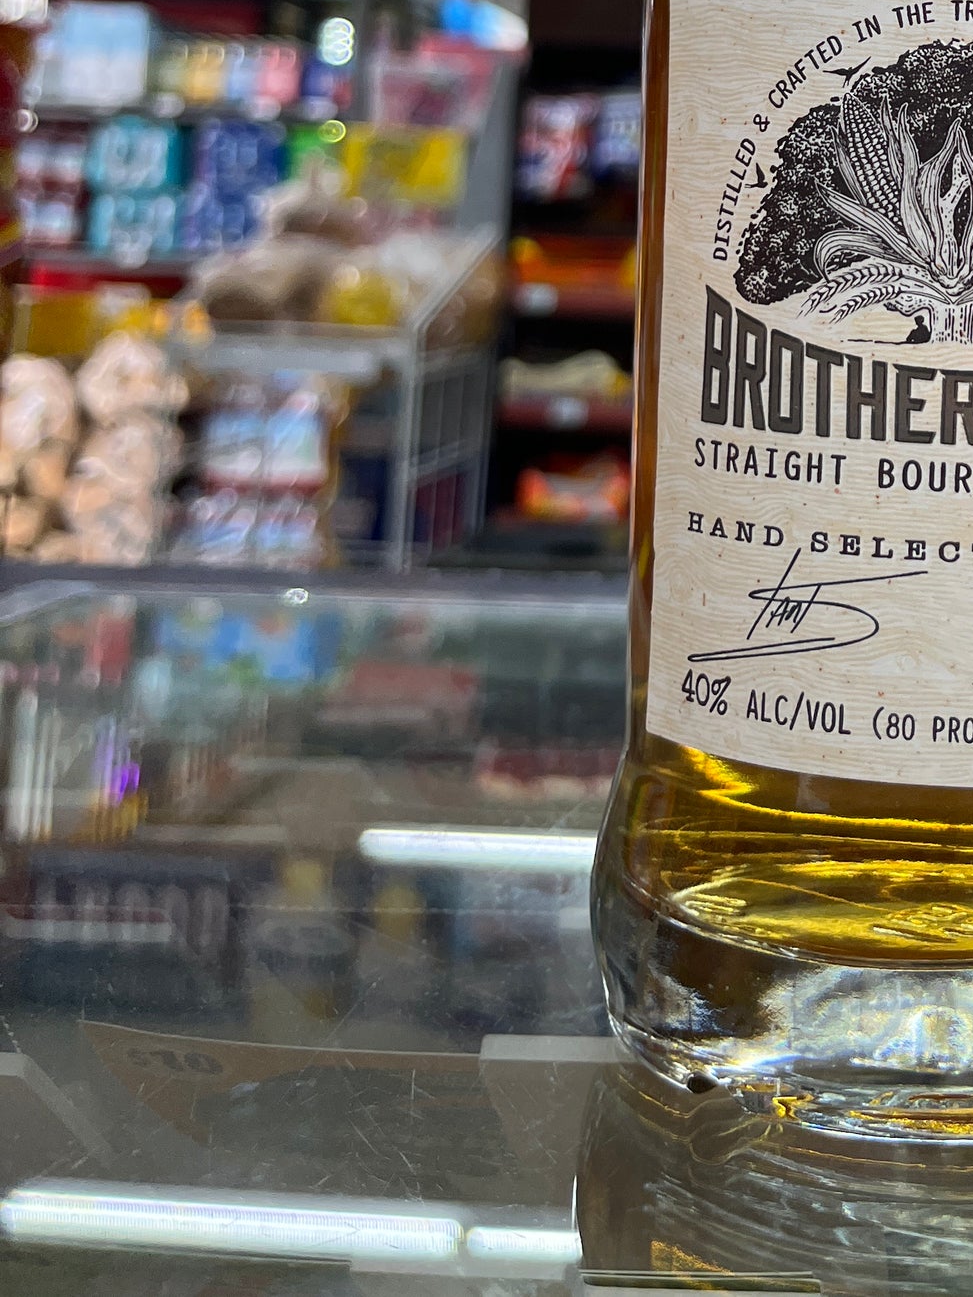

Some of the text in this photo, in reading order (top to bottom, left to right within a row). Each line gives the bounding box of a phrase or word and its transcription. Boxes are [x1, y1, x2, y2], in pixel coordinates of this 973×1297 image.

[712, 137, 756, 262] DISTILLED
[753, 113, 770, 132] &
[767, 35, 843, 109] CRAFTED
[851, 14, 881, 43] IN
[892, 1, 935, 28] THE
[695, 437, 847, 487] STRAIGHT
[687, 510, 785, 548] HAND
[680, 668, 730, 717] 40%
[746, 690, 852, 736] ALC/VOL
[872, 708, 916, 742] (80
